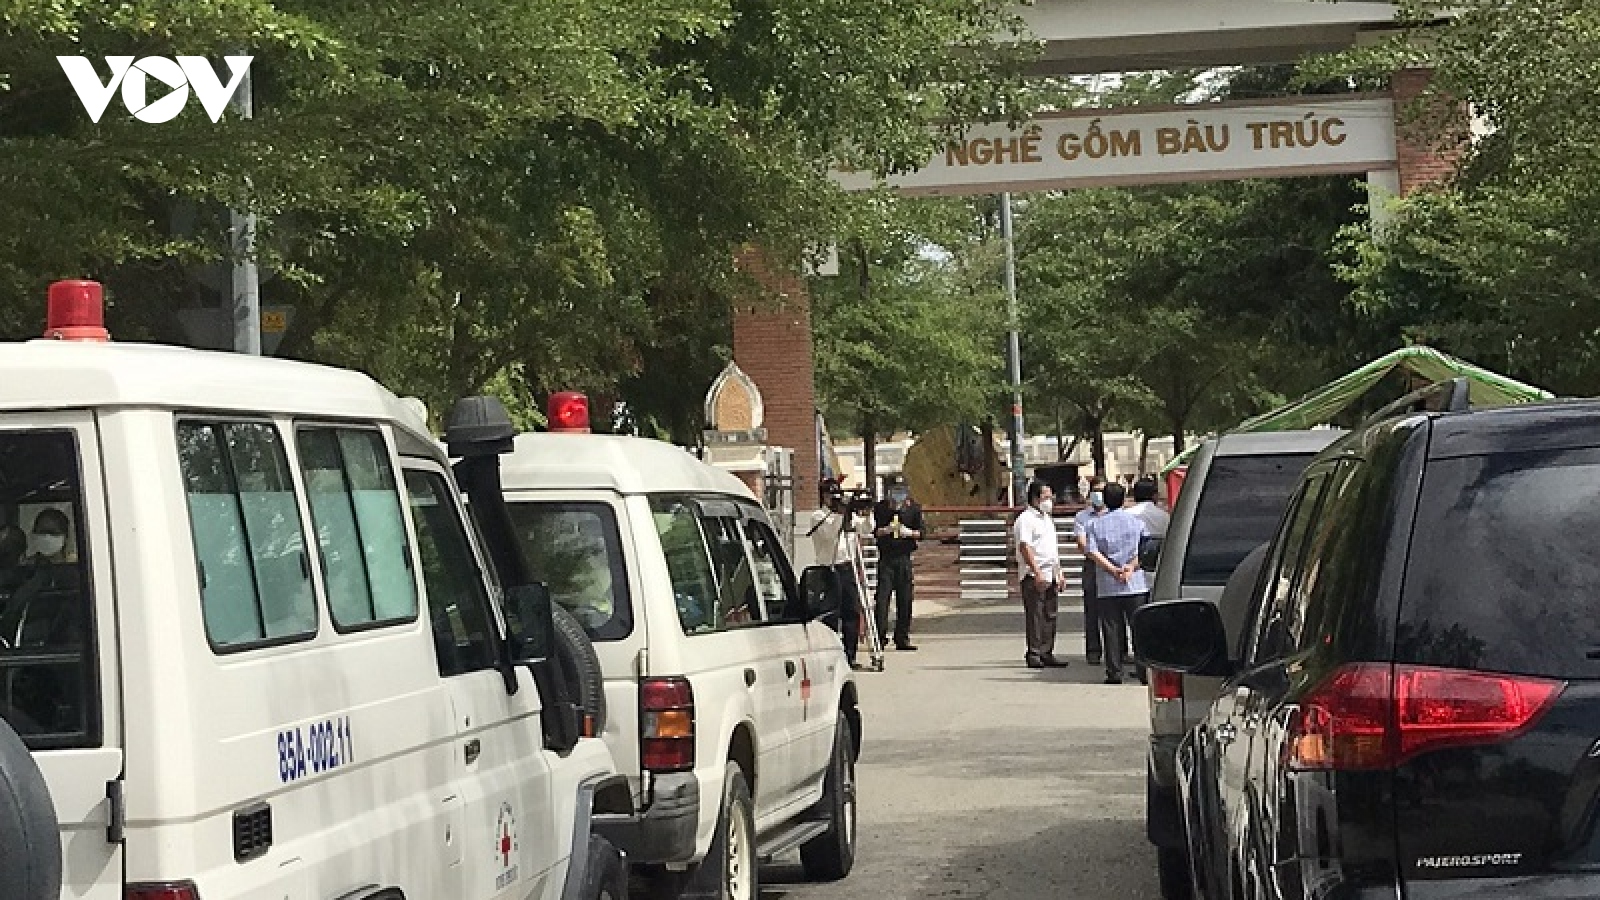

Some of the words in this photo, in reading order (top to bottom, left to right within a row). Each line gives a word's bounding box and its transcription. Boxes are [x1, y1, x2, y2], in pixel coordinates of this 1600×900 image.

[945, 123, 1043, 167] NGHỀ
[1057, 118, 1141, 160] GỐM
[1155, 118, 1230, 156] BÀU
[1246, 111, 1348, 150] TRÚC
